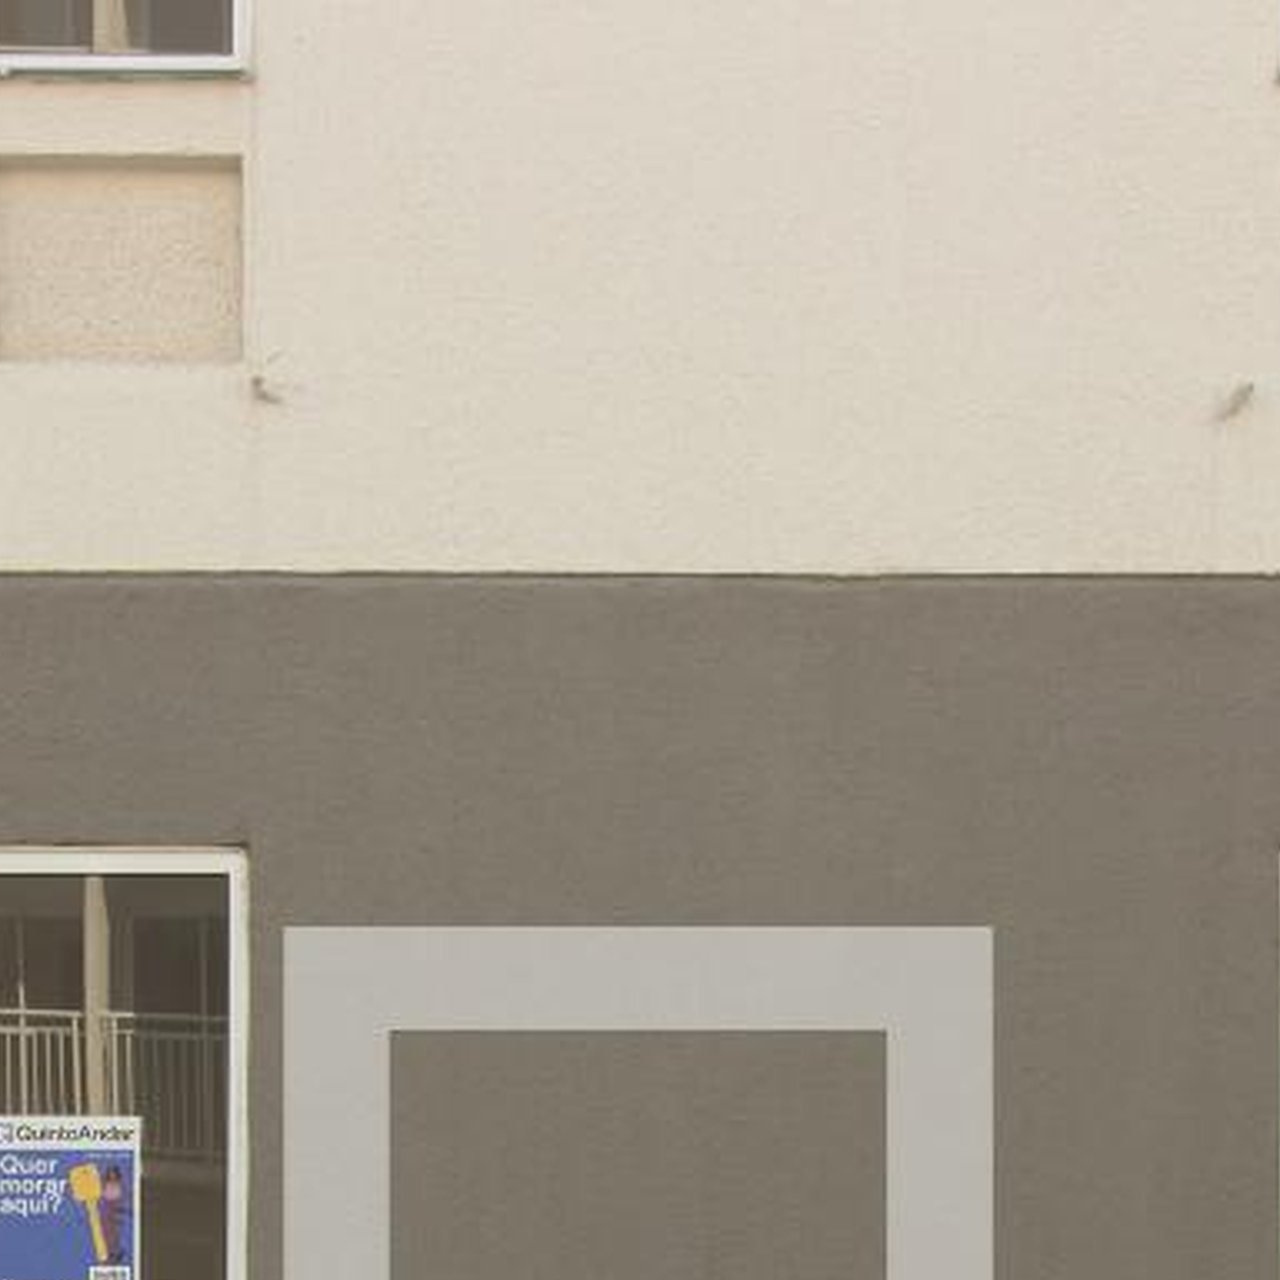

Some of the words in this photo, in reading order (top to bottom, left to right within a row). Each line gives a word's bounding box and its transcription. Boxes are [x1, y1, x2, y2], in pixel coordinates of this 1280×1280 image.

[16, 1125, 135, 1142] QuintoAndar
[0, 1153, 59, 1175] Quer
[0, 1178, 68, 1195] morar
[0, 1192, 62, 1217] aqui?
